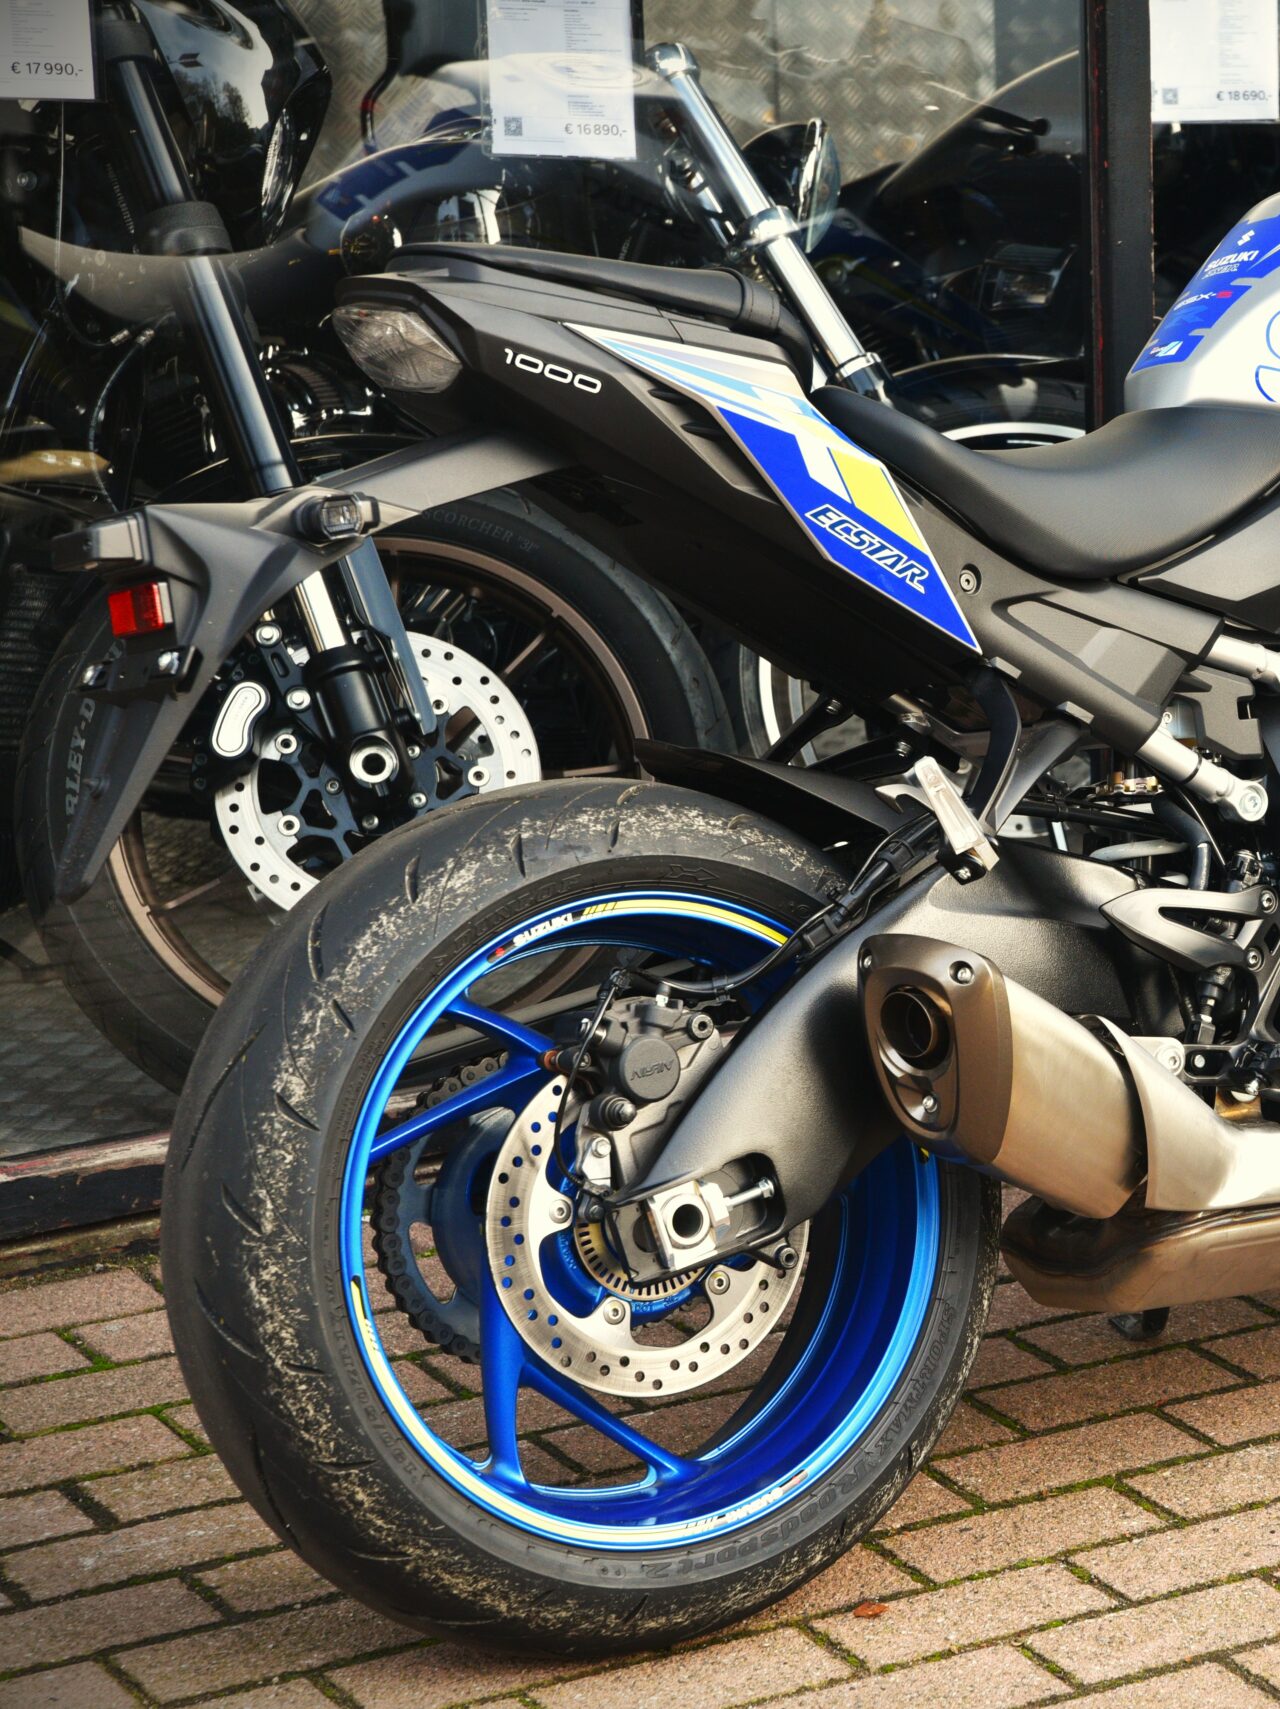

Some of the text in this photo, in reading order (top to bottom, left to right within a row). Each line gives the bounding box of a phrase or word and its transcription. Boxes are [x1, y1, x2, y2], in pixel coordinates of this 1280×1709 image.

[1204, 250, 1260, 273] SUZUKI
[504, 347, 602, 394] 1000
[804, 503, 929, 595] ECSTAR
[512, 912, 574, 948] SUZUKI
[874, 1300, 956, 1455] SPORTMAX
[676, 1460, 869, 1575] Roadsport
